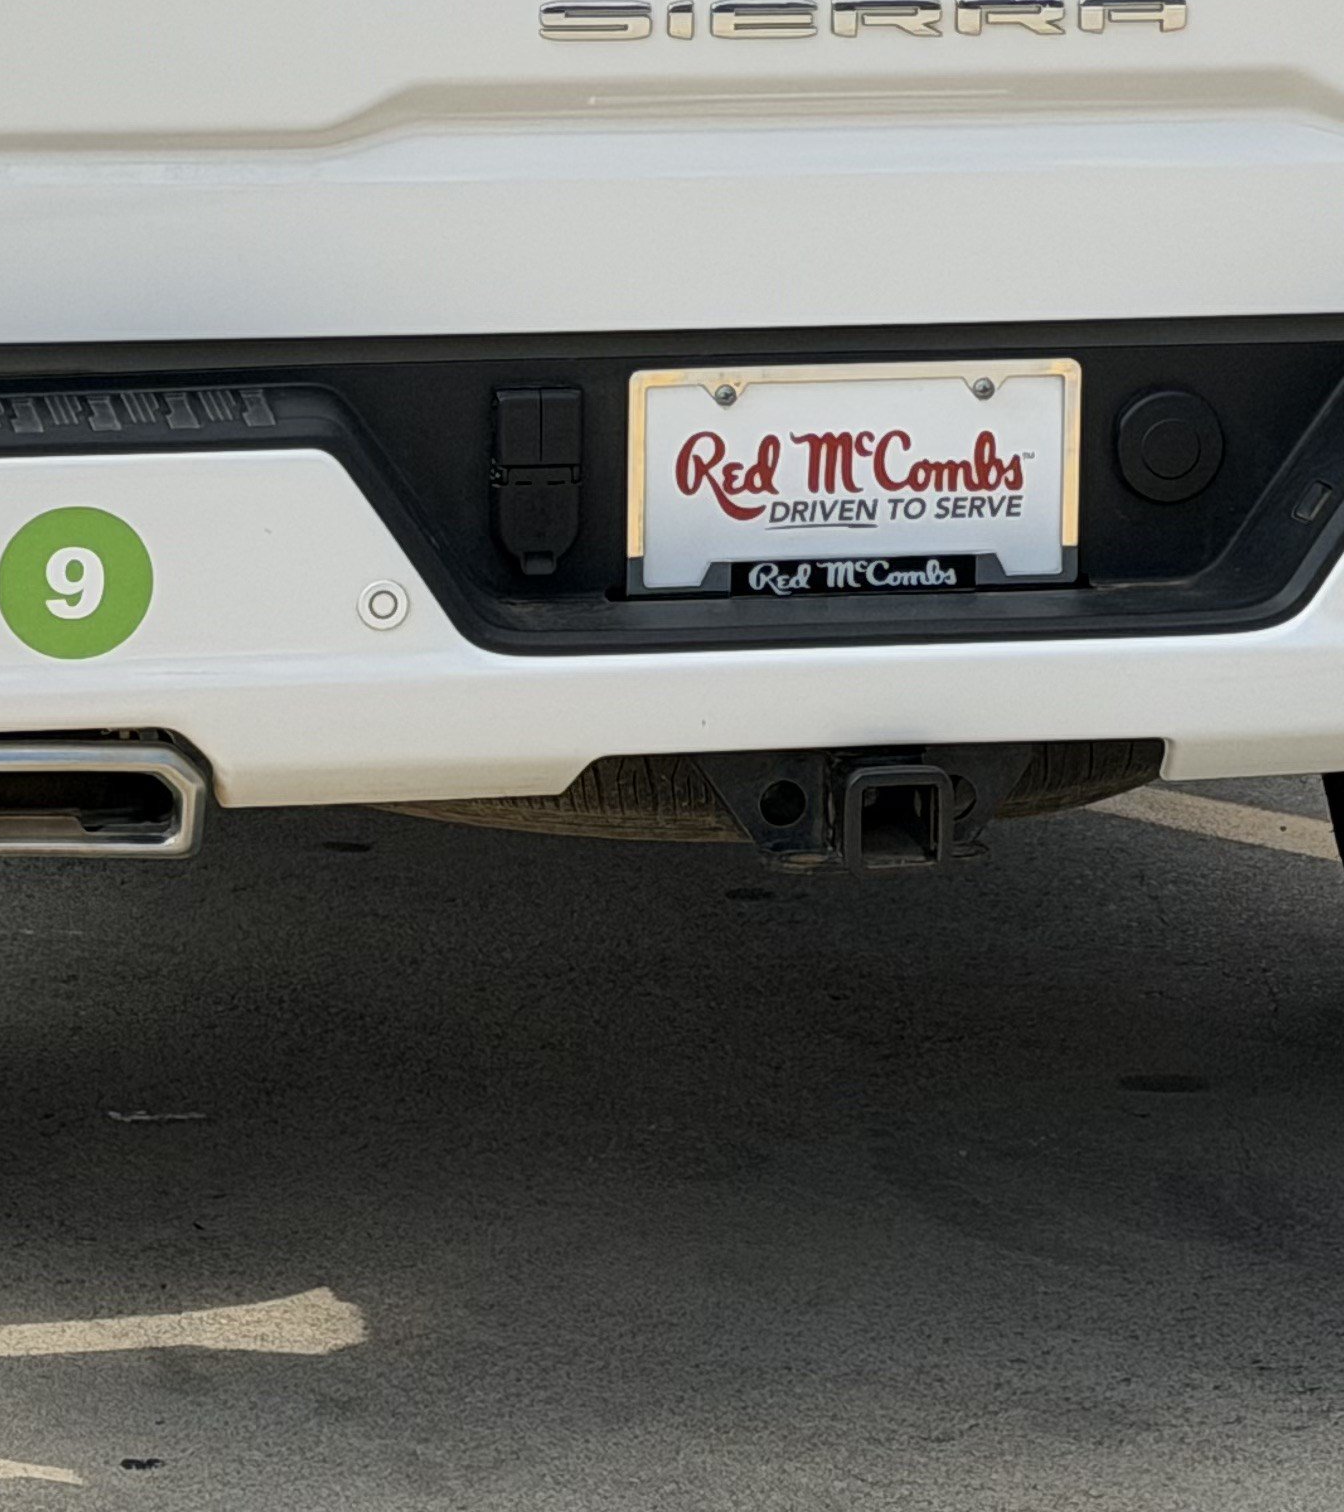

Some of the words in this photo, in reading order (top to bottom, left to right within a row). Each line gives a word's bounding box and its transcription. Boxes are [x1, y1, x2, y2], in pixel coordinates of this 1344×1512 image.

[676, 430, 782, 521] Red
[790, 429, 1024, 495] McCombs
[768, 498, 878, 524] DRIVEN
[889, 497, 927, 520] TO
[935, 494, 1024, 519] SERVE
[45, 546, 105, 620] 9
[748, 562, 811, 595] Red
[816, 559, 958, 588] McCombs
